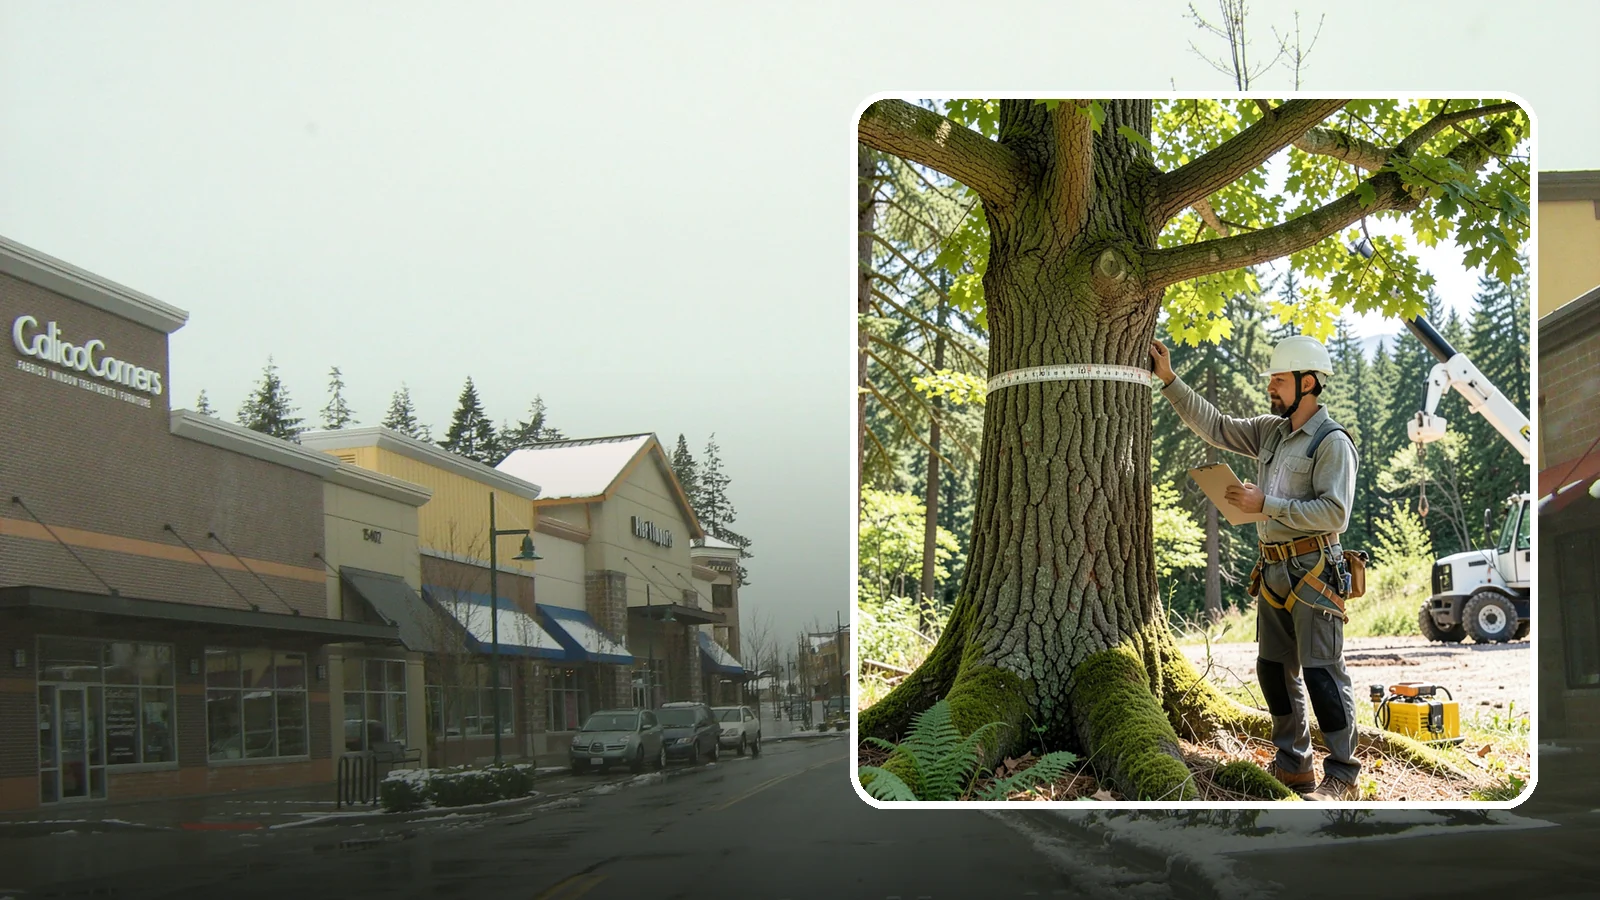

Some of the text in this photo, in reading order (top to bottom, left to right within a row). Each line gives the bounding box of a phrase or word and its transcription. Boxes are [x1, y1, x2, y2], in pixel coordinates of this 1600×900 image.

[17, 360, 151, 409] FABRICS WINDOW TREATMENTS FURNITURE
